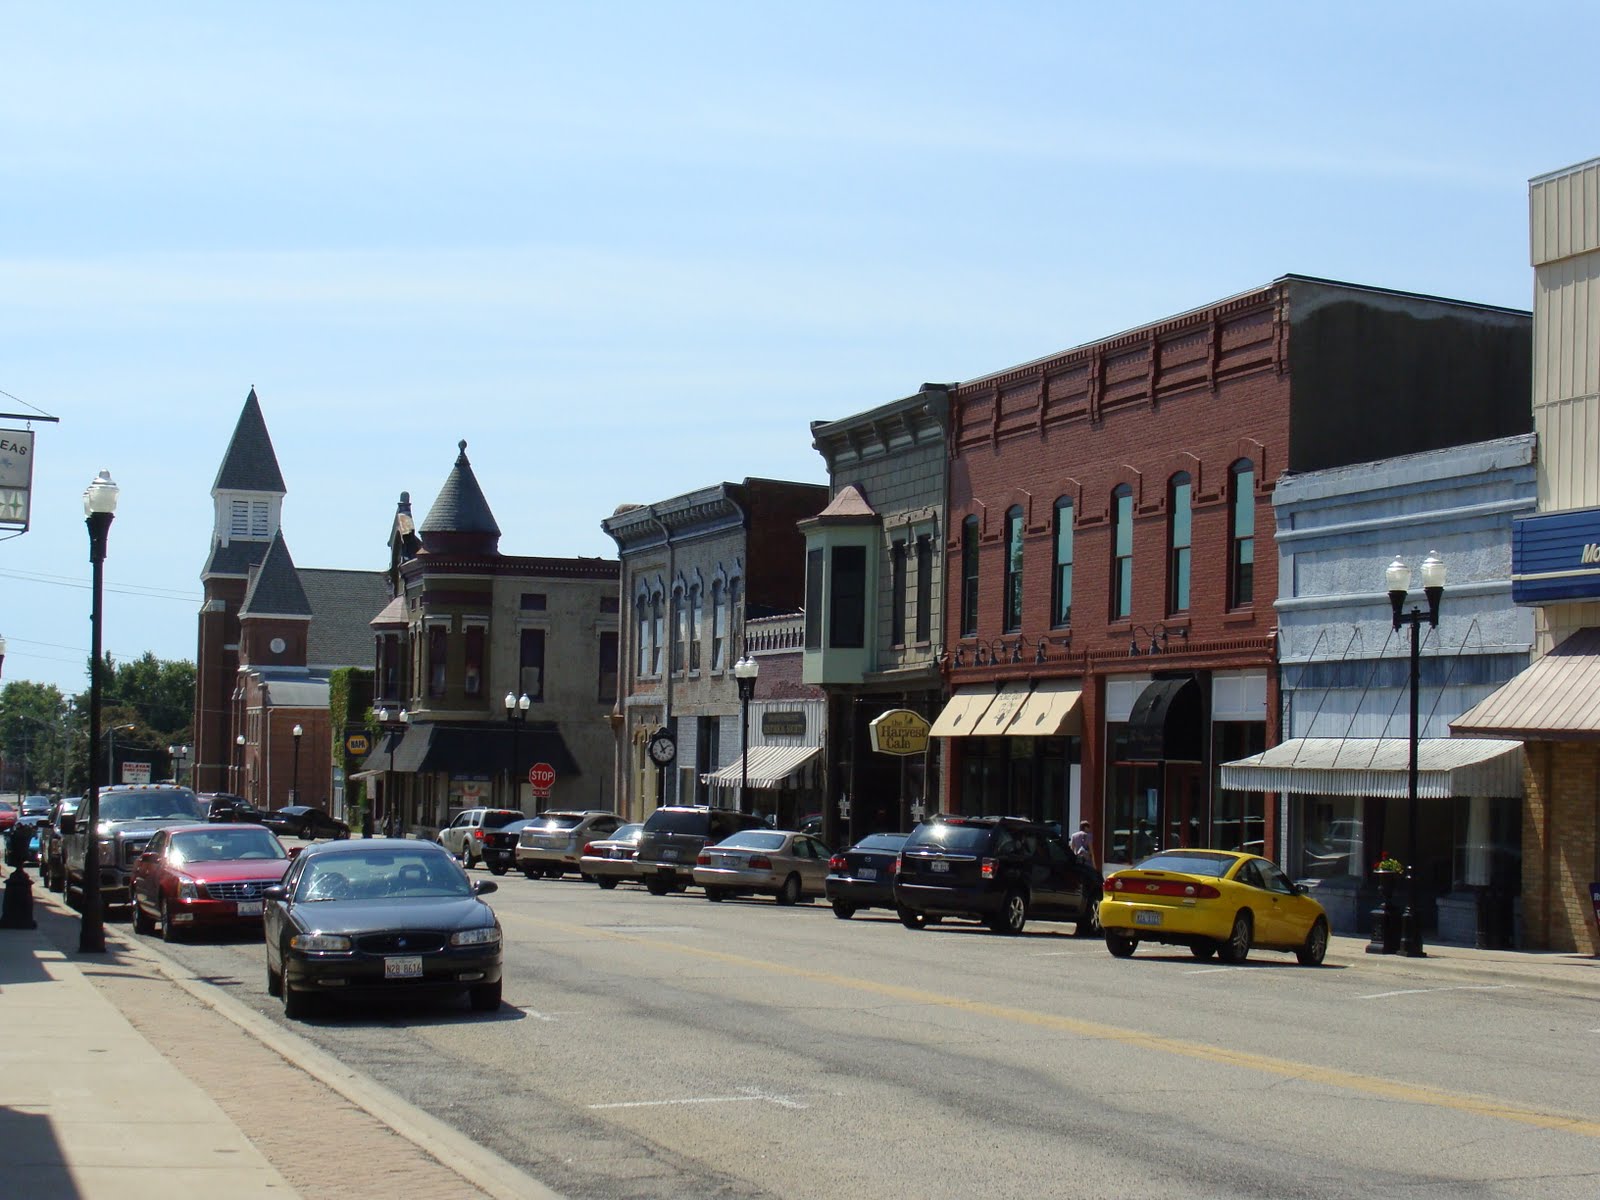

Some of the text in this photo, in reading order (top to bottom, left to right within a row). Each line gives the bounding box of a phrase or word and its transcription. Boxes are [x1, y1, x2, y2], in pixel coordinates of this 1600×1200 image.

[881, 725, 927, 738] Harvest
[350, 739, 366, 749] NAPA
[886, 736, 911, 749] Cafe
[531, 770, 554, 781] STOP
